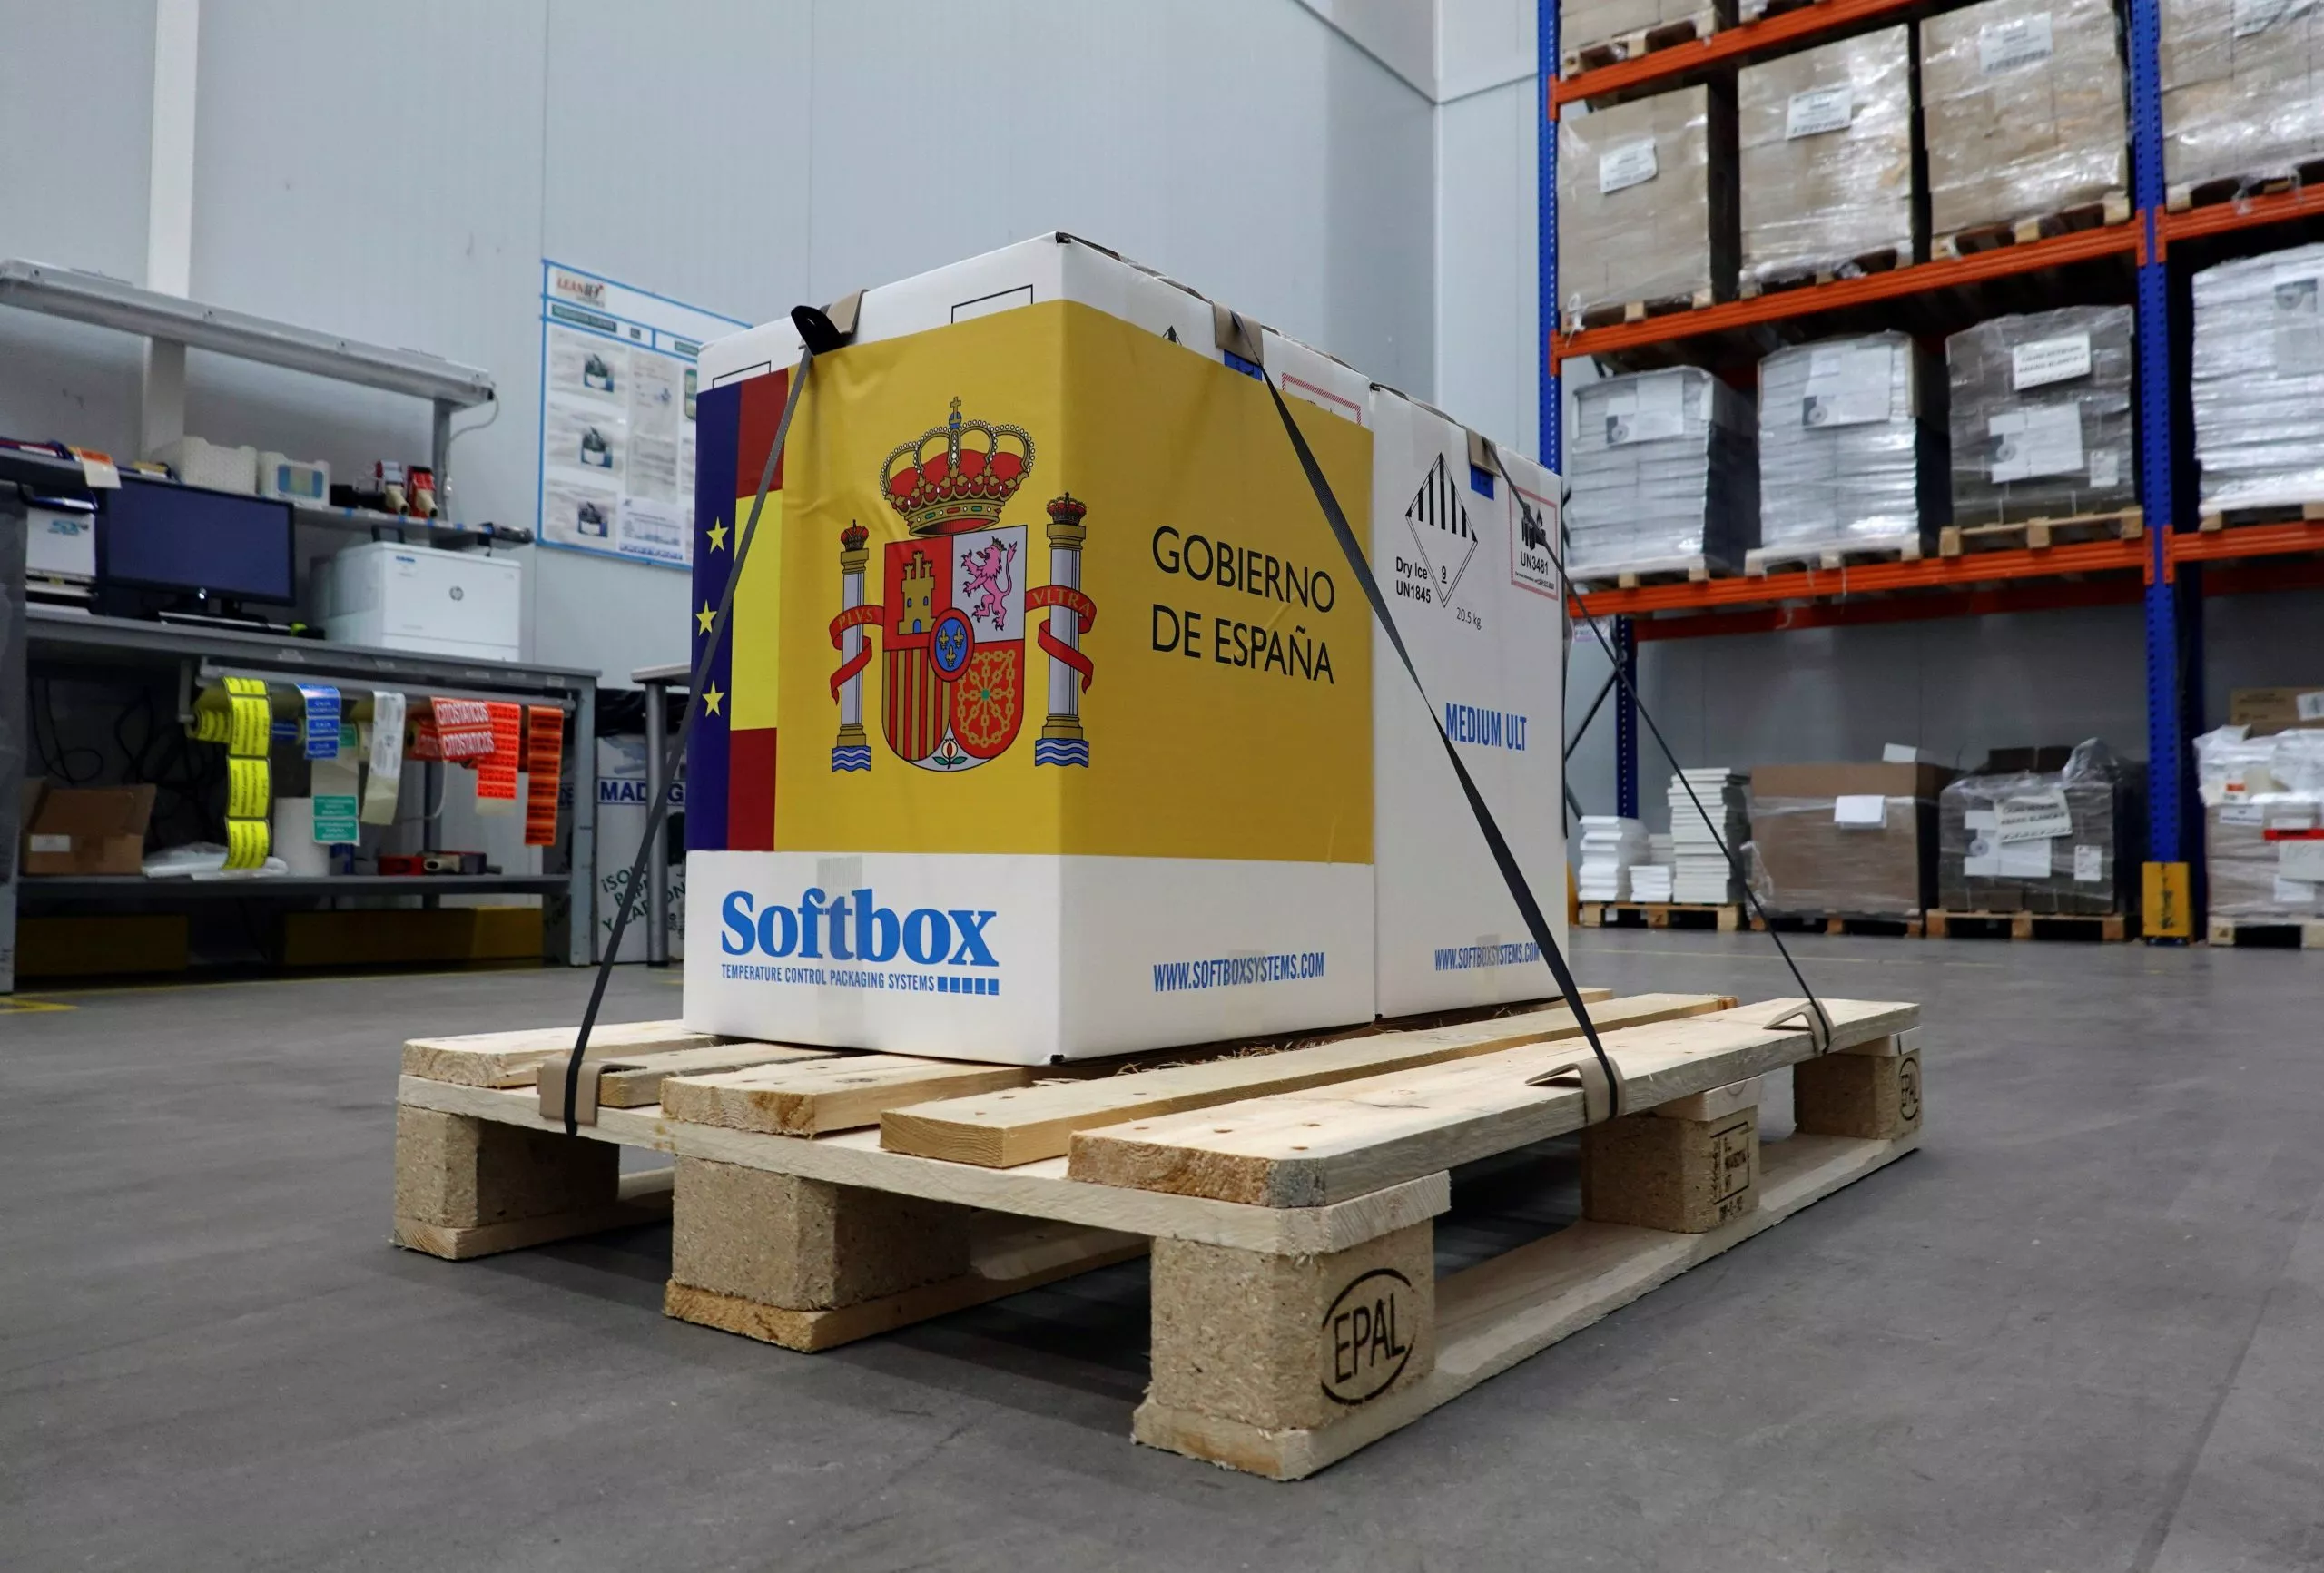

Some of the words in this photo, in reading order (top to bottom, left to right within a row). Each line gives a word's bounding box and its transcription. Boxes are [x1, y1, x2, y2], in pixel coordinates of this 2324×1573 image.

[1152, 526, 1334, 613] GOBIERNO
[1396, 556, 1412, 578] Dry
[1415, 562, 1428, 579] Ice
[1441, 565, 1447, 580] 9
[1521, 551, 1548, 575] UN3481
[1032, 588, 1090, 617] VLTRA
[1396, 579, 1431, 604] UN1845
[838, 609, 873, 629] PLVS
[1456, 607, 1472, 624] 20.5
[1152, 604, 1201, 658] DE
[1215, 617, 1334, 684] ESPAÑA
[1445, 703, 1501, 747] MEDIUM
[1505, 713, 1527, 751] ULT
[722, 888, 1000, 967] Softbox
[1434, 941, 1541, 971] WWW.SOFTBOXSYSTEMS.COM
[722, 964, 782, 982] TEMPERATURE
[785, 968, 827, 985] CONTROL
[830, 969, 884, 988] PACKAGING
[889, 973, 935, 992] SYSTEMS
[1153, 951, 1324, 992] WWW.SOFTBOXSYSTEMS.COM
[1334, 1292, 1406, 1384] EPAL
